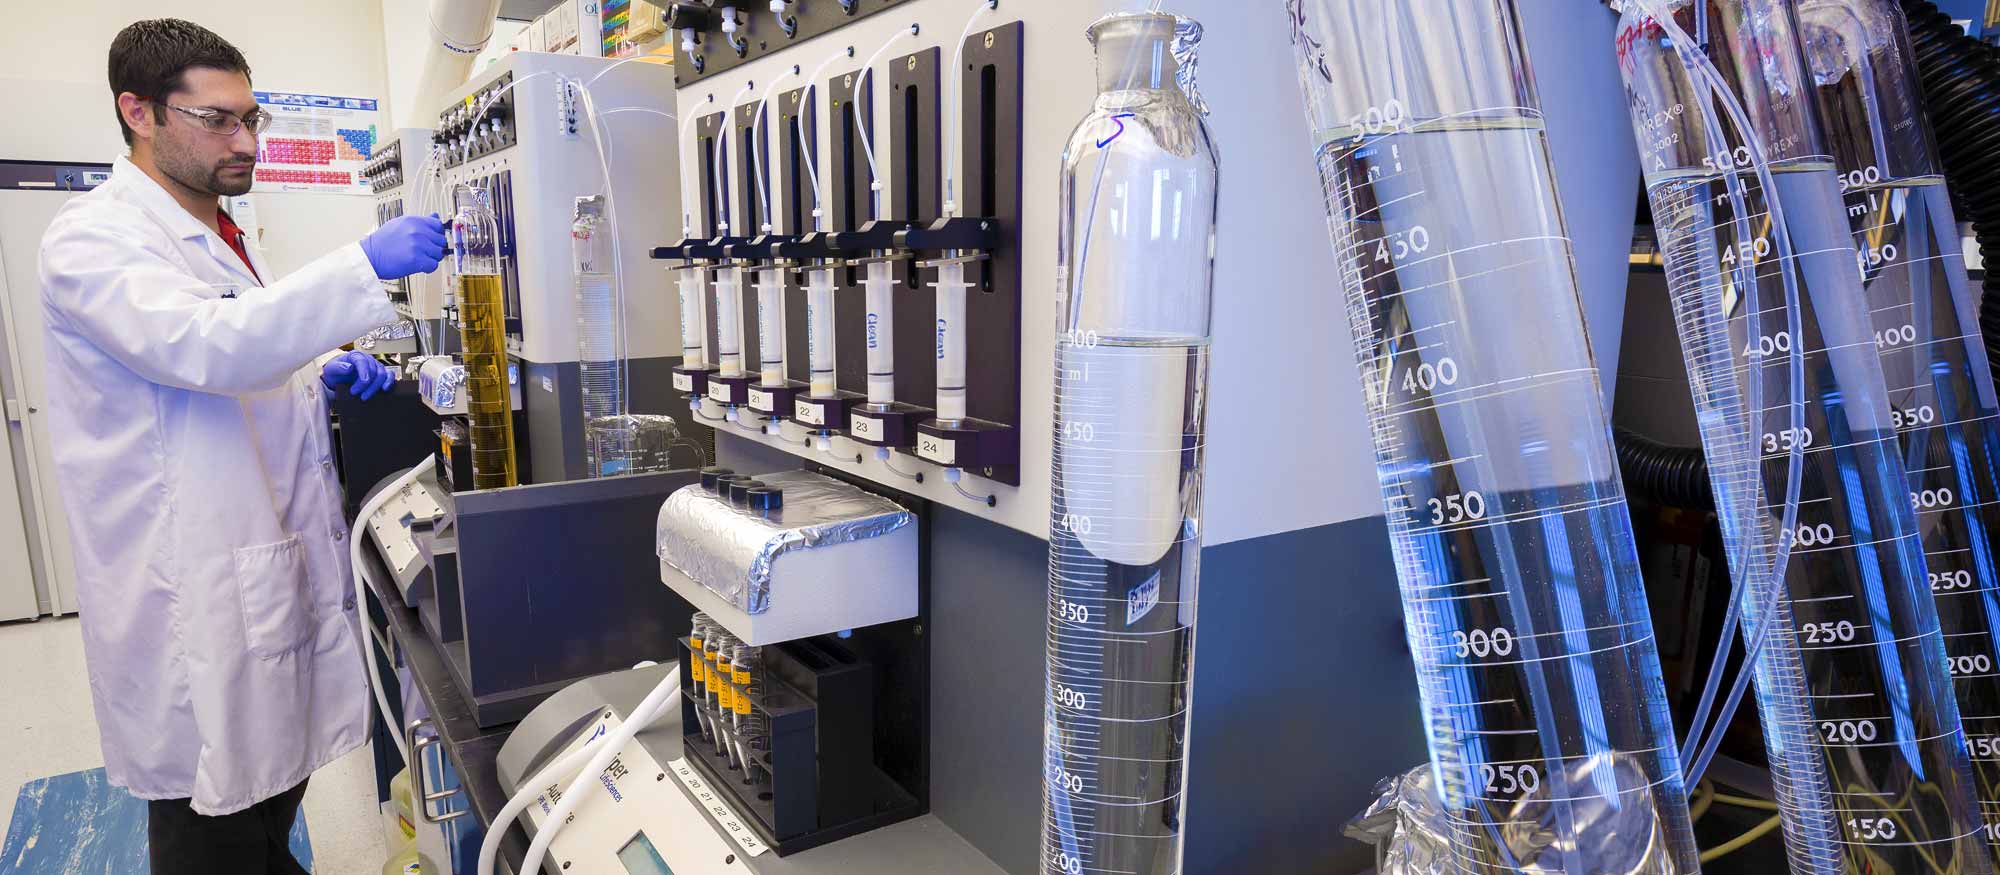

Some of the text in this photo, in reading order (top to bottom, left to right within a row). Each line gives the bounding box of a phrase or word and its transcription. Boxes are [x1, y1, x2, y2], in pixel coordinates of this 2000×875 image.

[1351, 99, 1404, 142] 500
[1702, 146, 1752, 176] 500
[1837, 166, 1880, 188] 500
[1849, 193, 1878, 217] ml
[1374, 226, 1430, 264] 450
[1858, 244, 1897, 268] 450
[868, 313, 878, 349] Clean
[937, 318, 947, 359] Clean
[1067, 329, 1097, 349] 500
[1874, 324, 1916, 348] 400
[1742, 331, 1791, 357] 400
[676, 377, 683, 386] 19
[1070, 362, 1089, 384] ml
[1402, 357, 1458, 394] 400
[752, 394, 760, 403] 21
[800, 406, 810, 417] 22
[1892, 405, 1934, 428] 350
[856, 421, 868, 432] 23
[1064, 421, 1094, 442] 450
[923, 440, 937, 453] 24
[1762, 427, 1813, 453] 350
[1427, 491, 1485, 525] 350
[1911, 487, 1953, 509] 300
[1061, 514, 1091, 535] 400
[1928, 569, 1972, 590] 250
[1060, 599, 1088, 623] 350
[1453, 627, 1512, 658] 300
[1802, 621, 1855, 643] 250
[1948, 654, 1991, 675] 200
[1057, 684, 1086, 710] 300
[1821, 720, 1877, 742] 200
[1965, 736, 2000, 757] 150
[1054, 766, 1083, 793] 250
[1479, 764, 1540, 793] 250
[679, 767, 756, 848] 19 20 21 22 23 24
[1847, 817, 1896, 840] 150
